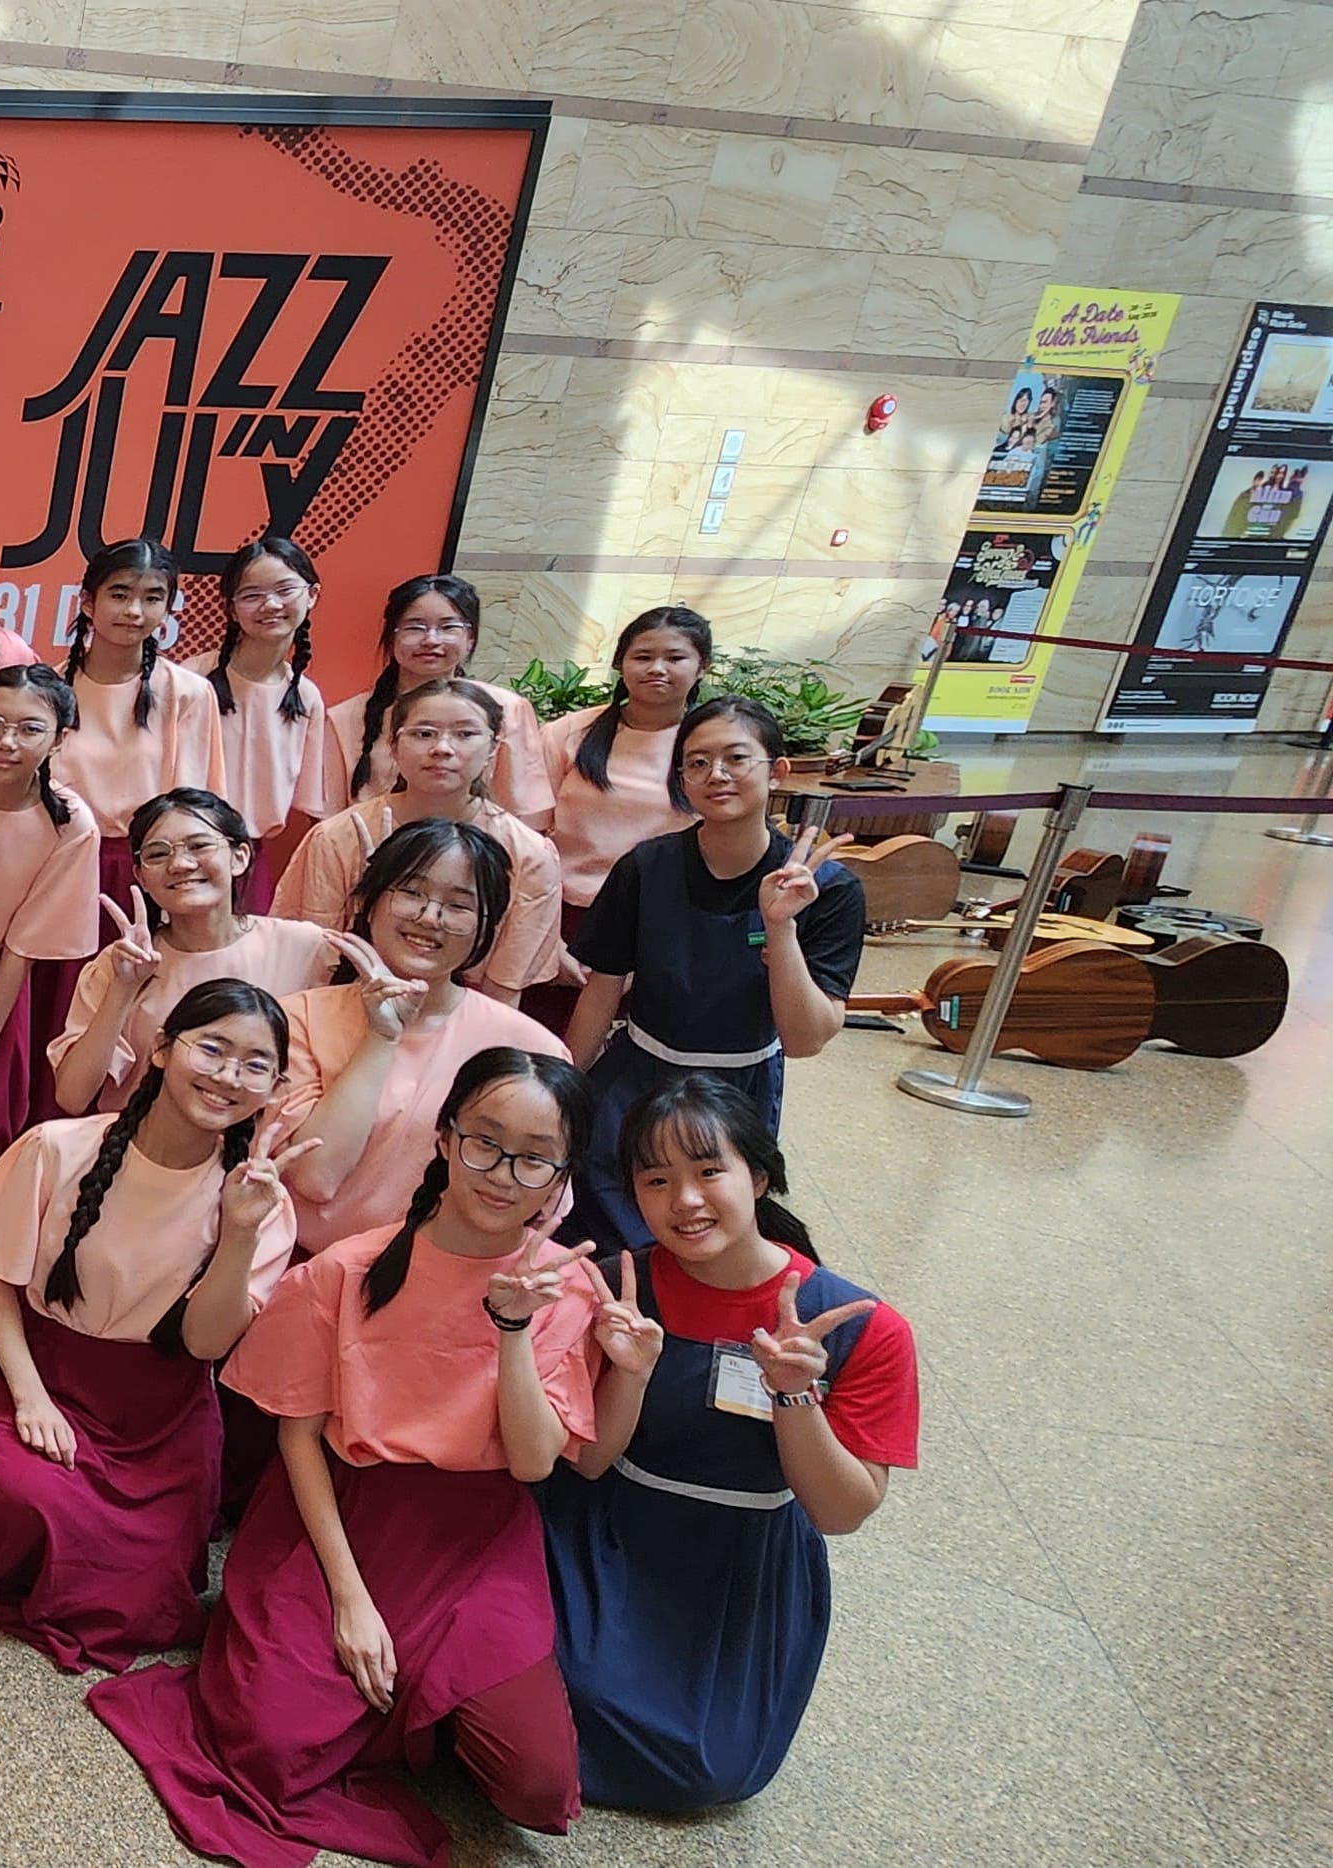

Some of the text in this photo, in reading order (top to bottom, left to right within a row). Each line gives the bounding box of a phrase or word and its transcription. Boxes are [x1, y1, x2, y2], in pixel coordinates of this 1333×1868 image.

[21, 250, 393, 422] JAZZ
[1036, 324, 1140, 347] With Friends
[1061, 303, 1081, 323] A
[1080, 303, 1125, 323] Date
[1216, 326, 1263, 430] esplanade
[0, 376, 361, 574] JULY
